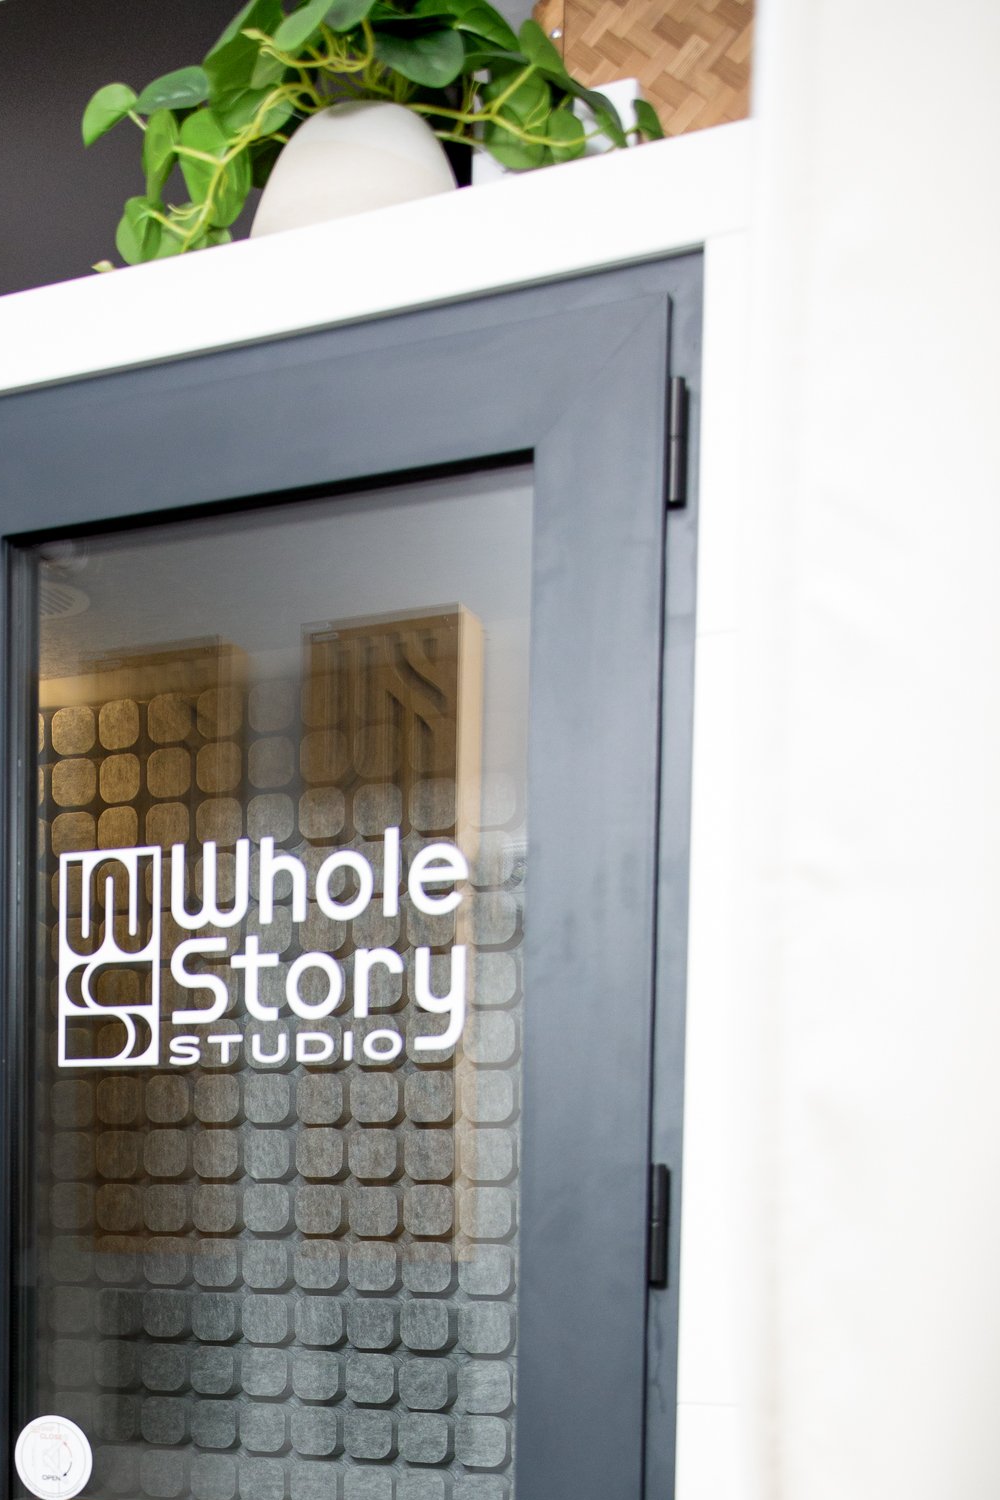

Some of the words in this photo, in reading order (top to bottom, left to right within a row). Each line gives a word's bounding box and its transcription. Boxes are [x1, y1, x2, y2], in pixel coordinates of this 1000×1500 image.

[171, 826, 469, 931] Whole
[170, 935, 467, 1051] Story
[169, 1029, 404, 1065] STUDIO
